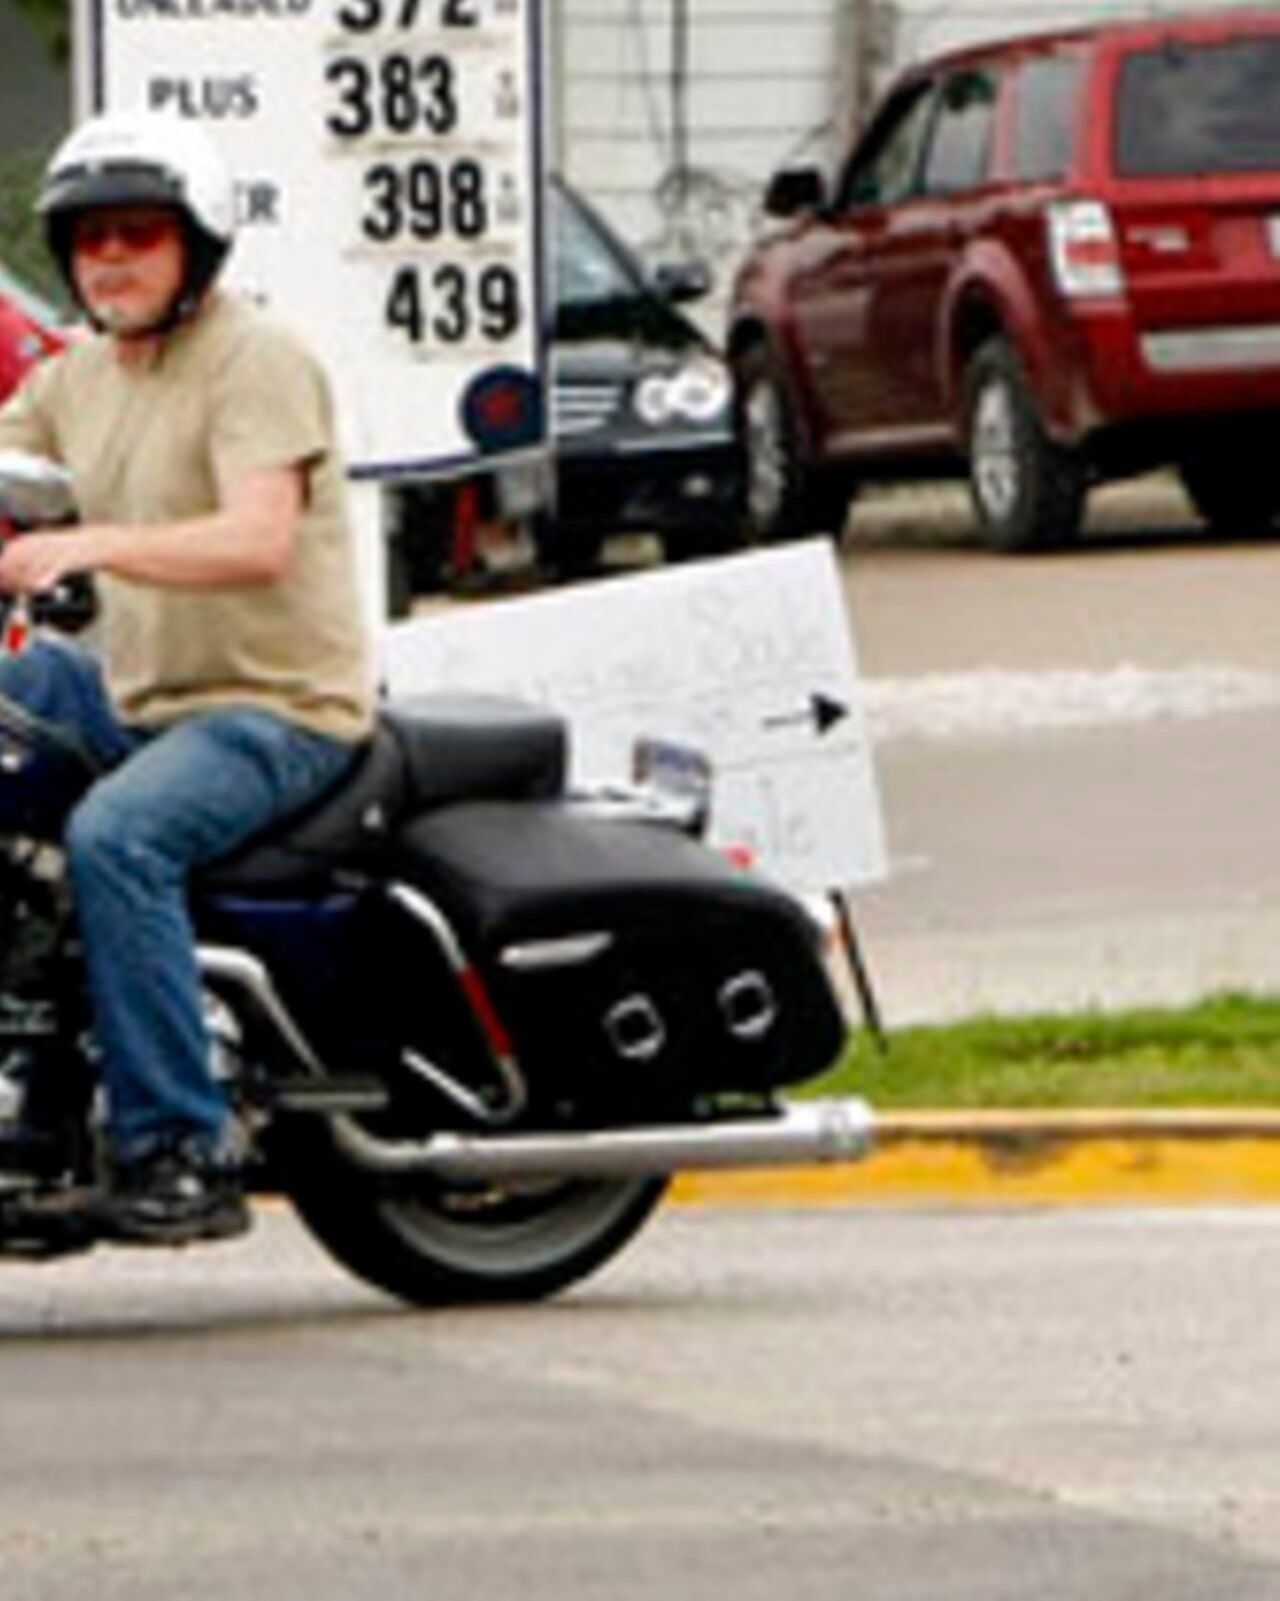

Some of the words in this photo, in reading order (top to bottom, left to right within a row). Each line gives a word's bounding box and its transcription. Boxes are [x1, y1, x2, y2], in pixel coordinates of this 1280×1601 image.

[147, 76, 258, 119] PLUS
[325, 53, 458, 138] 383
[361, 158, 487, 242] 398
[384, 264, 522, 343] 439
